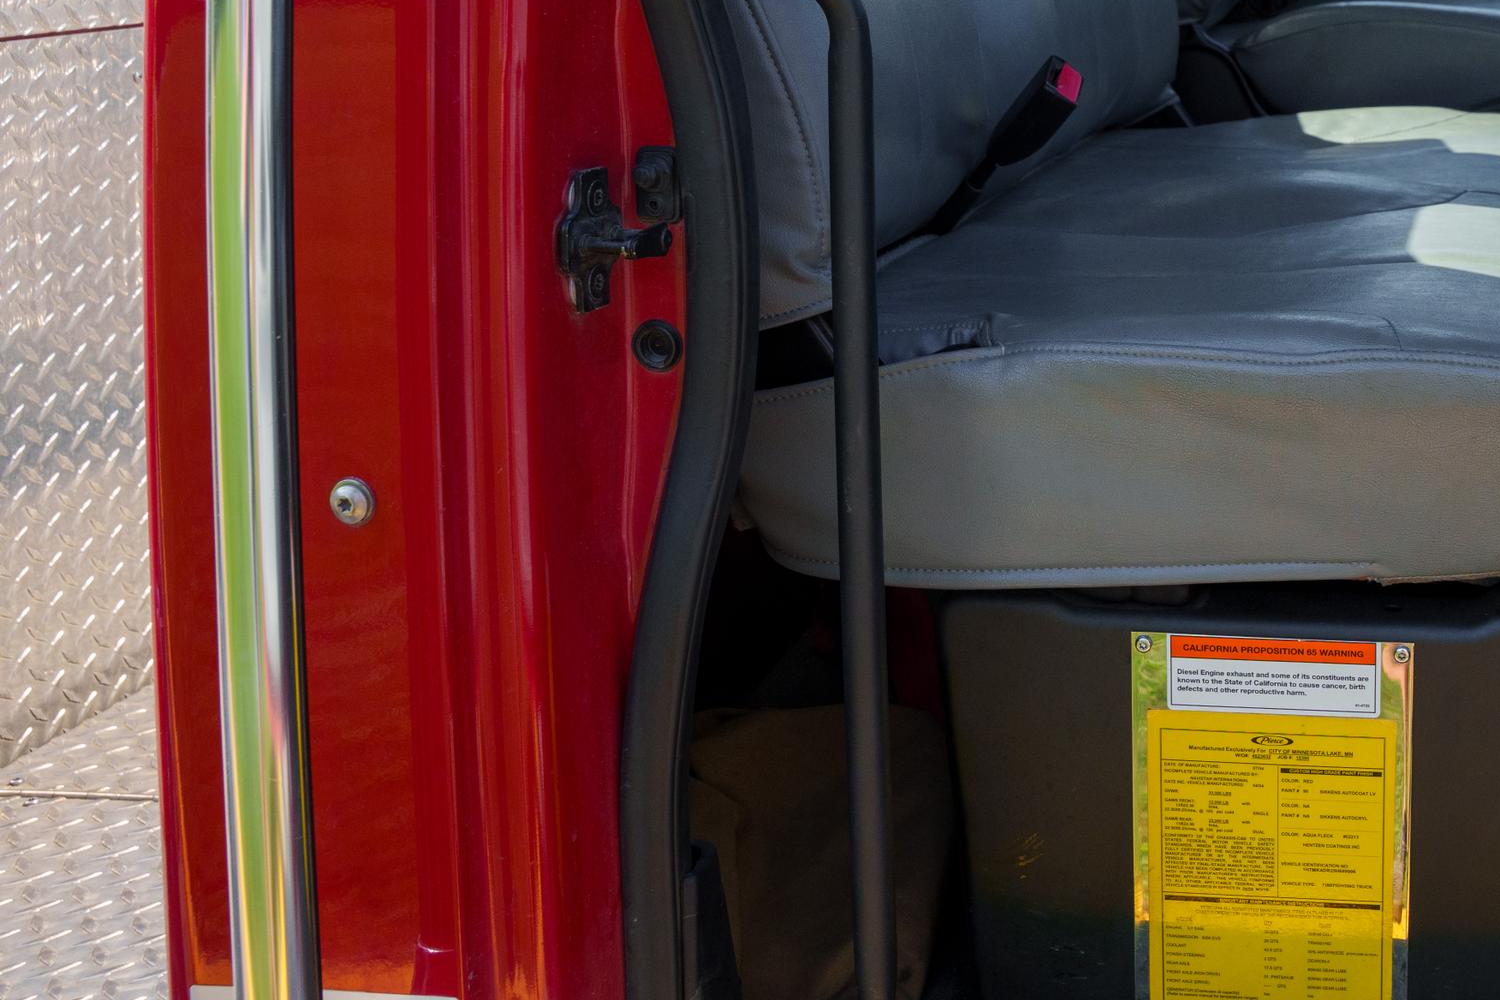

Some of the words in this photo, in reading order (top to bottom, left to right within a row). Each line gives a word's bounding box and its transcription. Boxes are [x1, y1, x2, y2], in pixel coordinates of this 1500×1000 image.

[1183, 644, 1238, 653] CALIFORNIA
[1241, 646, 1304, 655] PROPOSITION
[1320, 649, 1364, 658] WARNING
